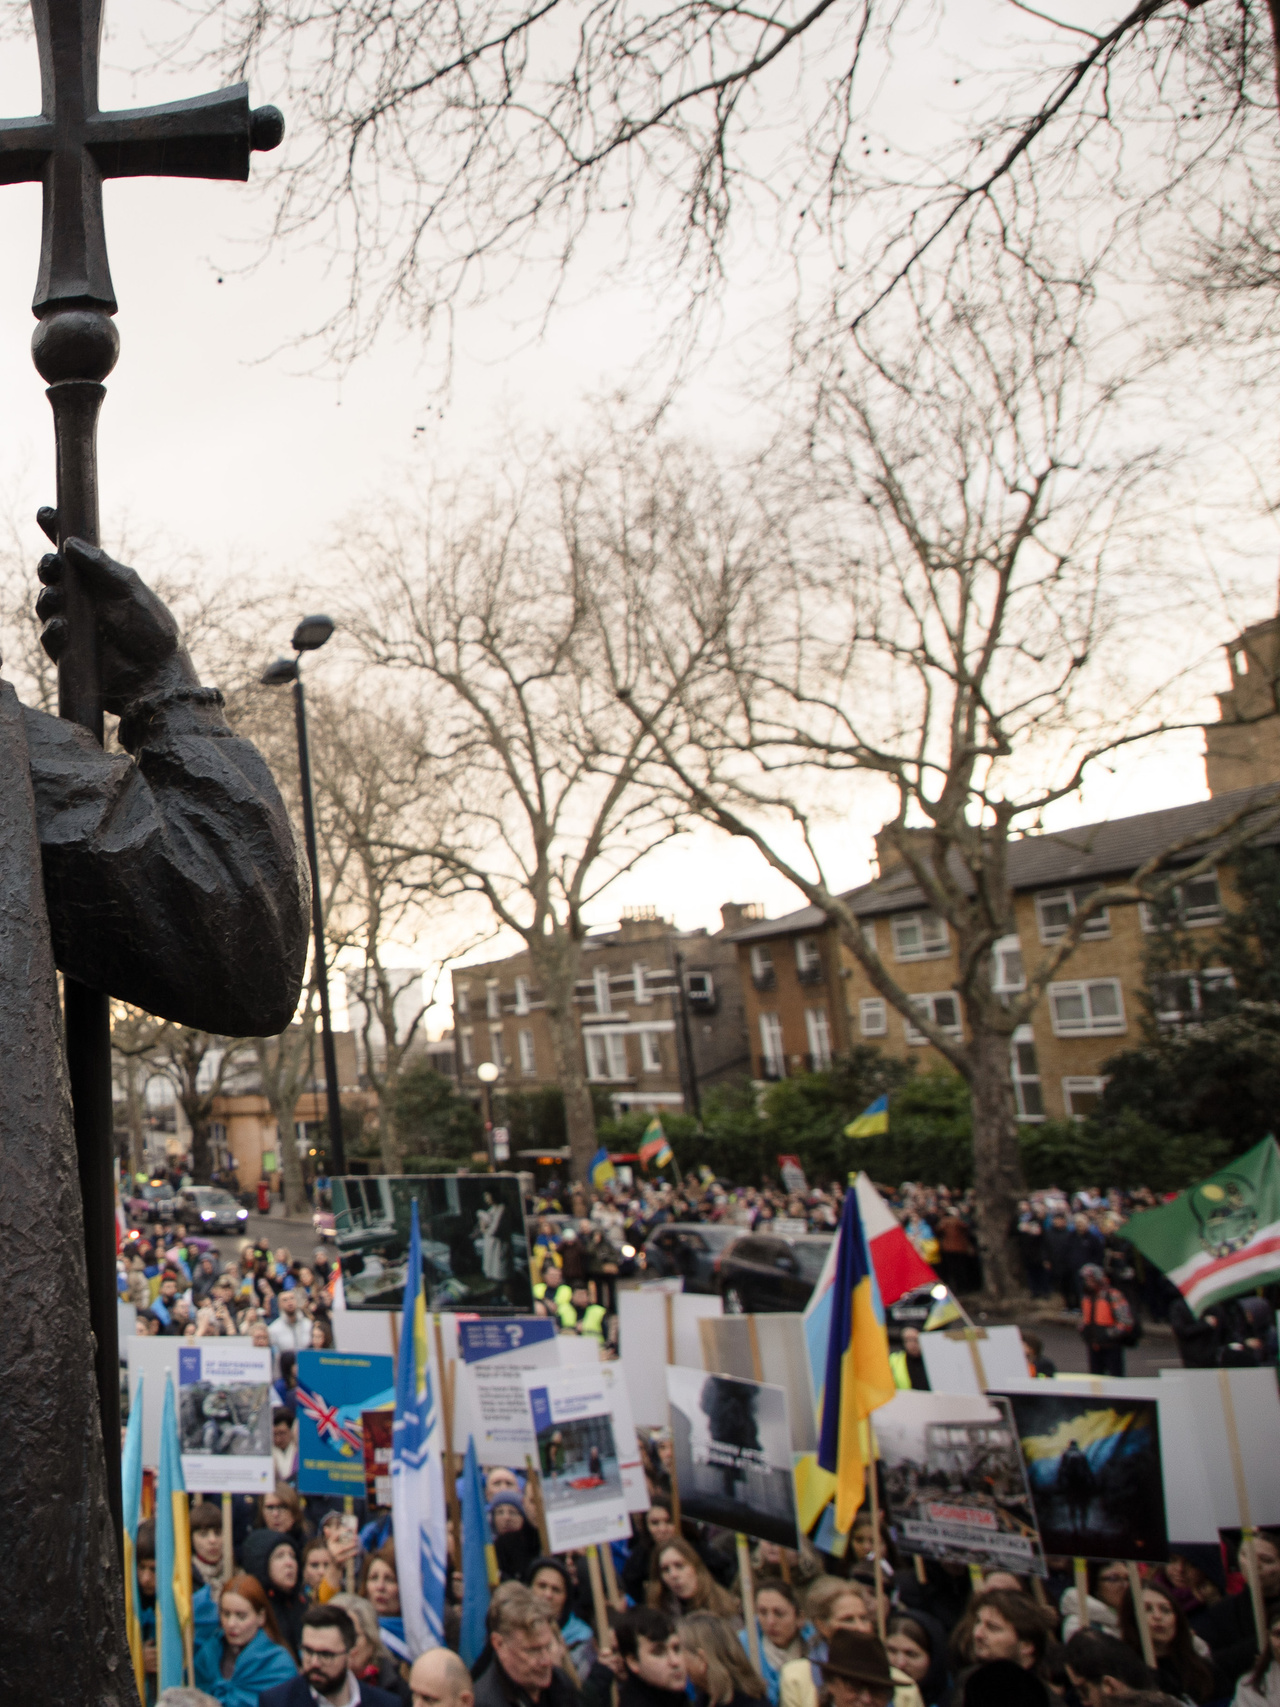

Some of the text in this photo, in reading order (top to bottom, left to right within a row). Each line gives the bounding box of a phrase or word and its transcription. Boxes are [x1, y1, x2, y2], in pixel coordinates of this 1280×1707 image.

[504, 1324, 524, 1347] ?
[929, 1503, 993, 1524] DONETSK
[909, 1525, 1028, 1550] AFTER RUSSIAN ATTACK
